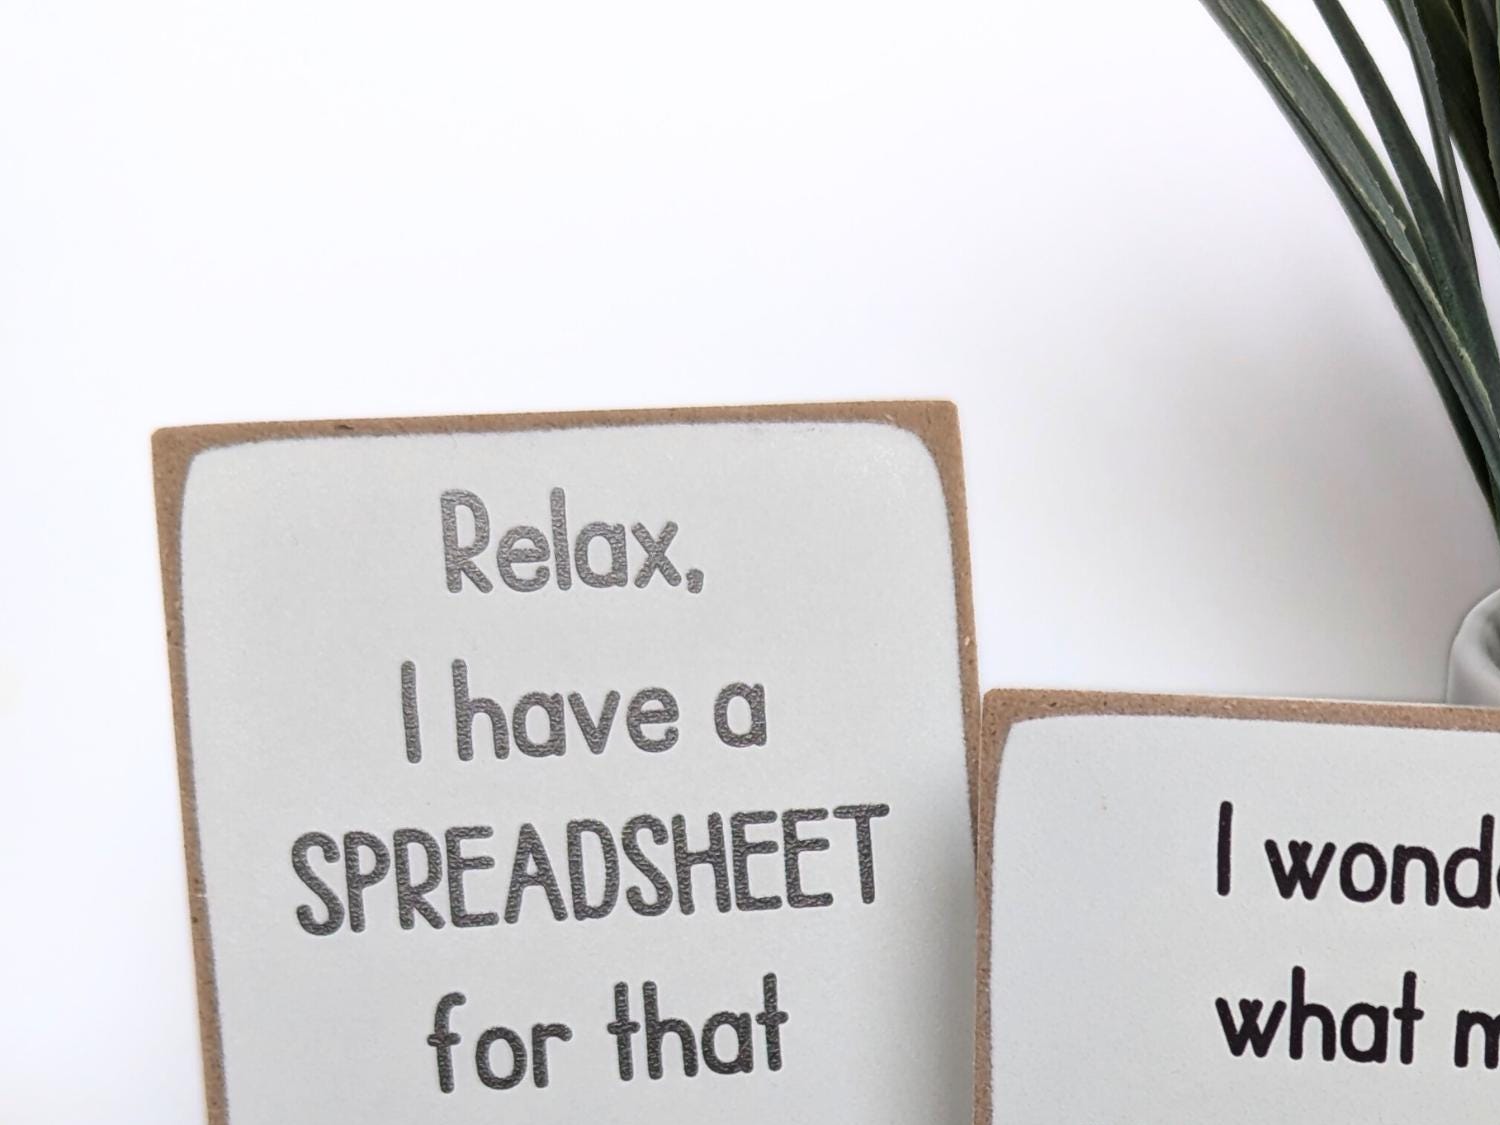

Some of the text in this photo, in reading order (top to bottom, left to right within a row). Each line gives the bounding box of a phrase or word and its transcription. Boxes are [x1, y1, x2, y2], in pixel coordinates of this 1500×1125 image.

[441, 488, 704, 594] Relax,
[401, 658, 768, 764] I have a
[290, 804, 892, 938] SPREADSHEET
[1216, 800, 1234, 897] I
[426, 972, 789, 1095] for that
[1214, 964, 1425, 1066] what
